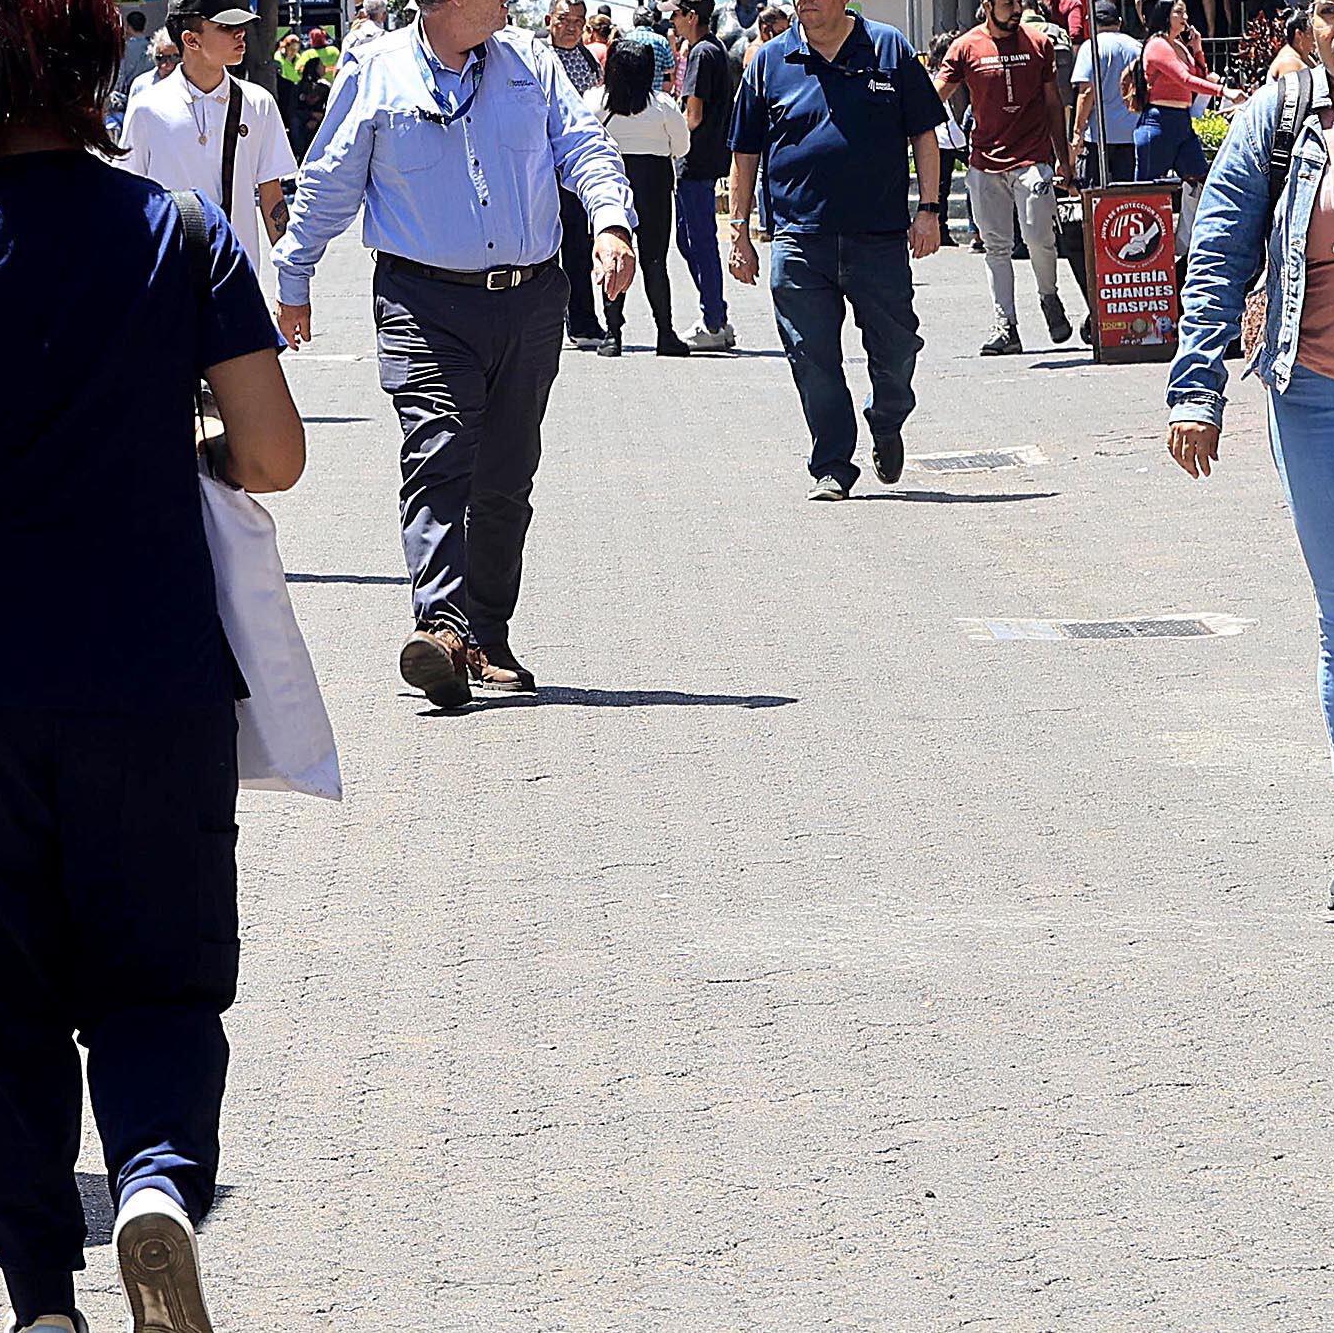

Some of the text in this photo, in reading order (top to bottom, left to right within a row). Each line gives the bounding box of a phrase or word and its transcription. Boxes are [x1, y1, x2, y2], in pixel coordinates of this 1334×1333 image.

[1110, 212, 1145, 238] JPS
[1104, 270, 1168, 285] LOTERÍA
[1100, 284, 1174, 300] CHANCES
[1107, 299, 1169, 314] RASPAS
